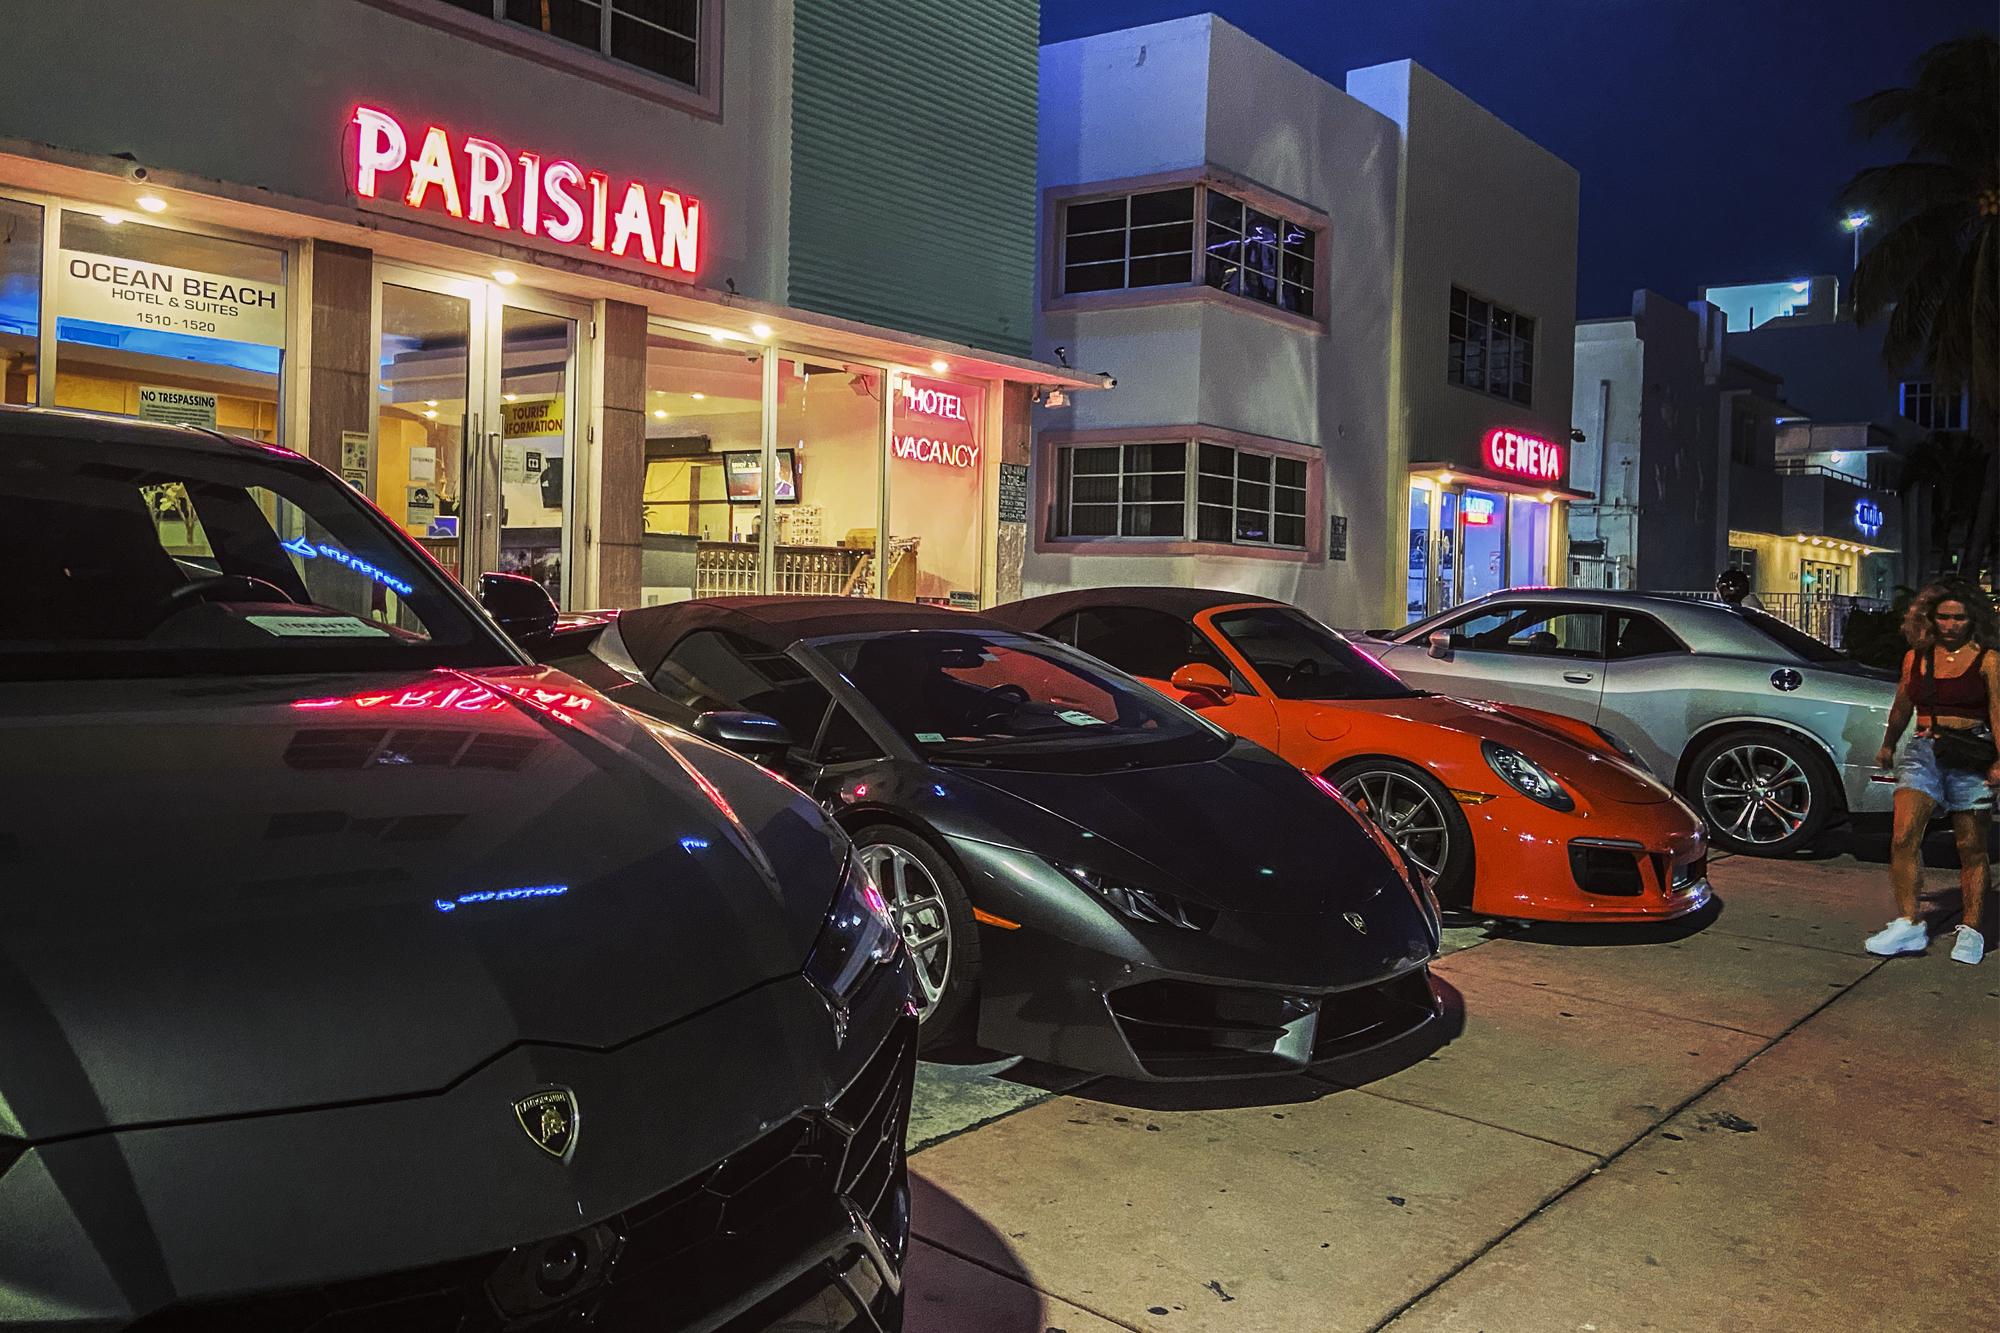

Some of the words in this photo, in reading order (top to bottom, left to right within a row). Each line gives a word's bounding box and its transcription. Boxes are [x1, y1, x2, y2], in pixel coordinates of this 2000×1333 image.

[353, 107, 700, 273] PARISIAN
[70, 259, 173, 292] OCEAN
[183, 277, 276, 309] BEACH
[111, 287, 164, 306] HOTEL
[168, 296, 180, 308] &
[184, 299, 239, 317] SUITES
[141, 390, 156, 402] NO
[158, 392, 215, 408] TRESPASSING
[512, 404, 549, 420] TOURIST
[909, 386, 966, 421] HOTEL
[504, 419, 563, 435] NFORMATION
[894, 435, 979, 468] VACANCY
[1491, 430, 1560, 481] GENEVA
